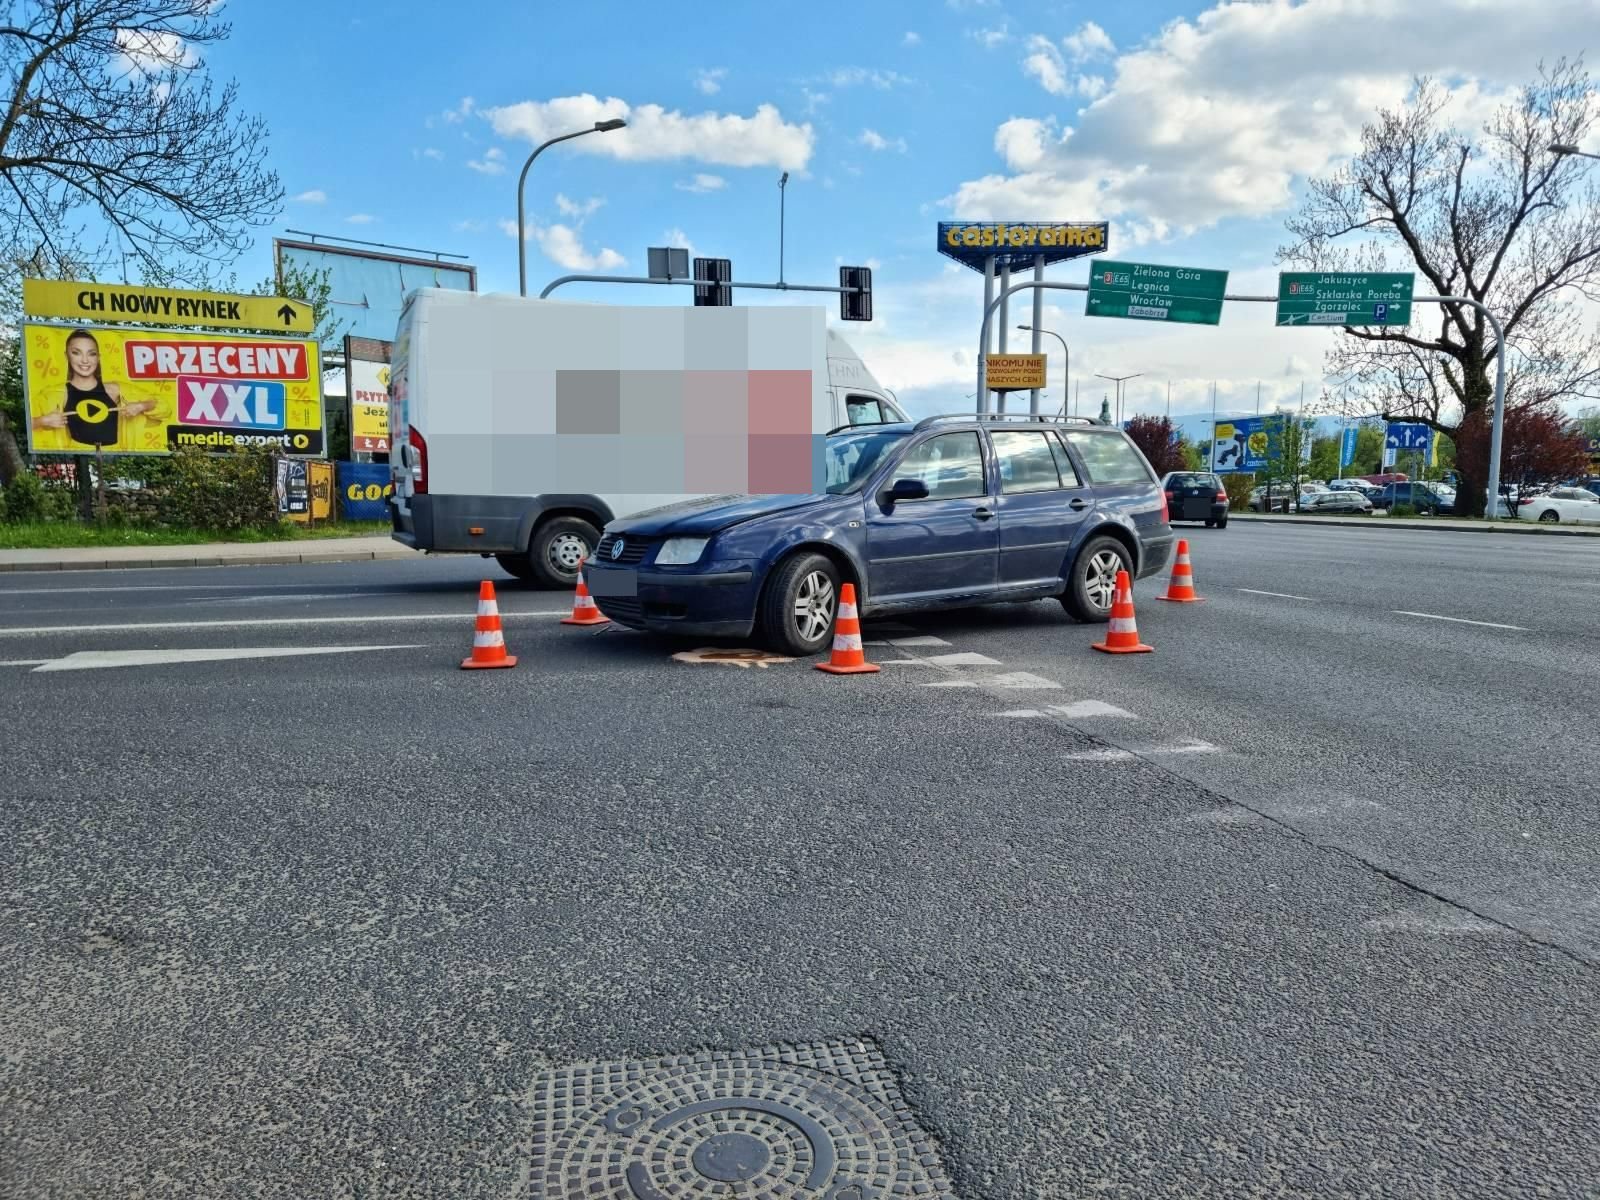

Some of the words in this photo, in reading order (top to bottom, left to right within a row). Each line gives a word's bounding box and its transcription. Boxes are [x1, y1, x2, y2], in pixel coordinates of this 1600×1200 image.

[947, 223, 1103, 246] castorama
[1104, 272, 1112, 283] 3
[1113, 273, 1129, 284] E65
[1133, 265, 1170, 279] Zielona
[1131, 280, 1170, 293] Legnica
[1318, 275, 1368, 287] Jakuszyce
[1130, 294, 1173, 307] Wrocław
[1316, 289, 1362, 300] Szklarska
[1367, 289, 1401, 301] Poręba
[77, 291, 105, 311] CH
[110, 293, 172, 316] NOWY
[176, 297, 240, 320] RYNEK
[1315, 302, 1361, 313] Zgorzelec
[132, 345, 299, 375] PRZECENY
[185, 381, 278, 425] XXL
[177, 431, 291, 448] mediaexpert
